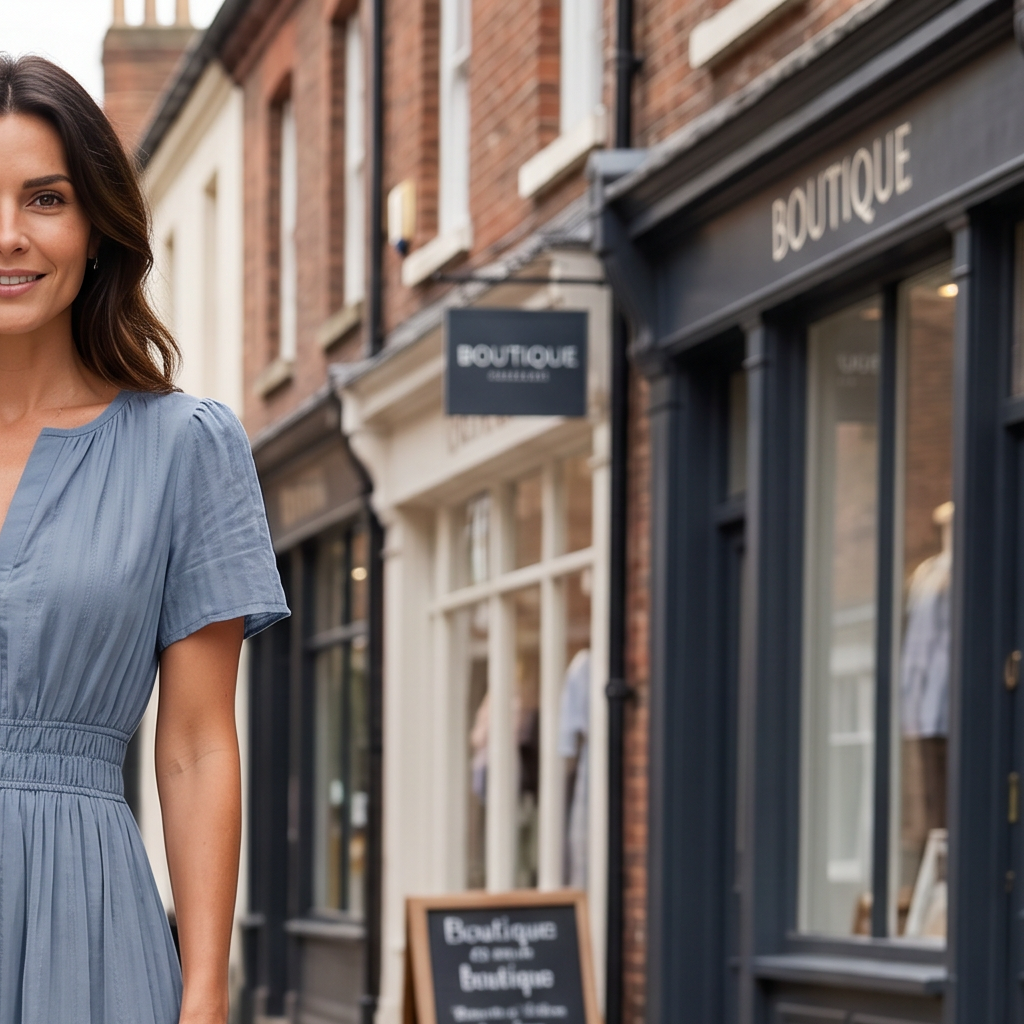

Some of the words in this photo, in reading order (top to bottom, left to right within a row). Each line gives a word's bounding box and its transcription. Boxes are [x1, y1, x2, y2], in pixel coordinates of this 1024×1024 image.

[772, 121, 912, 262] BOUTIQUE
[456, 344, 579, 369] BOUTIQUE
[443, 915, 557, 947] Boutique
